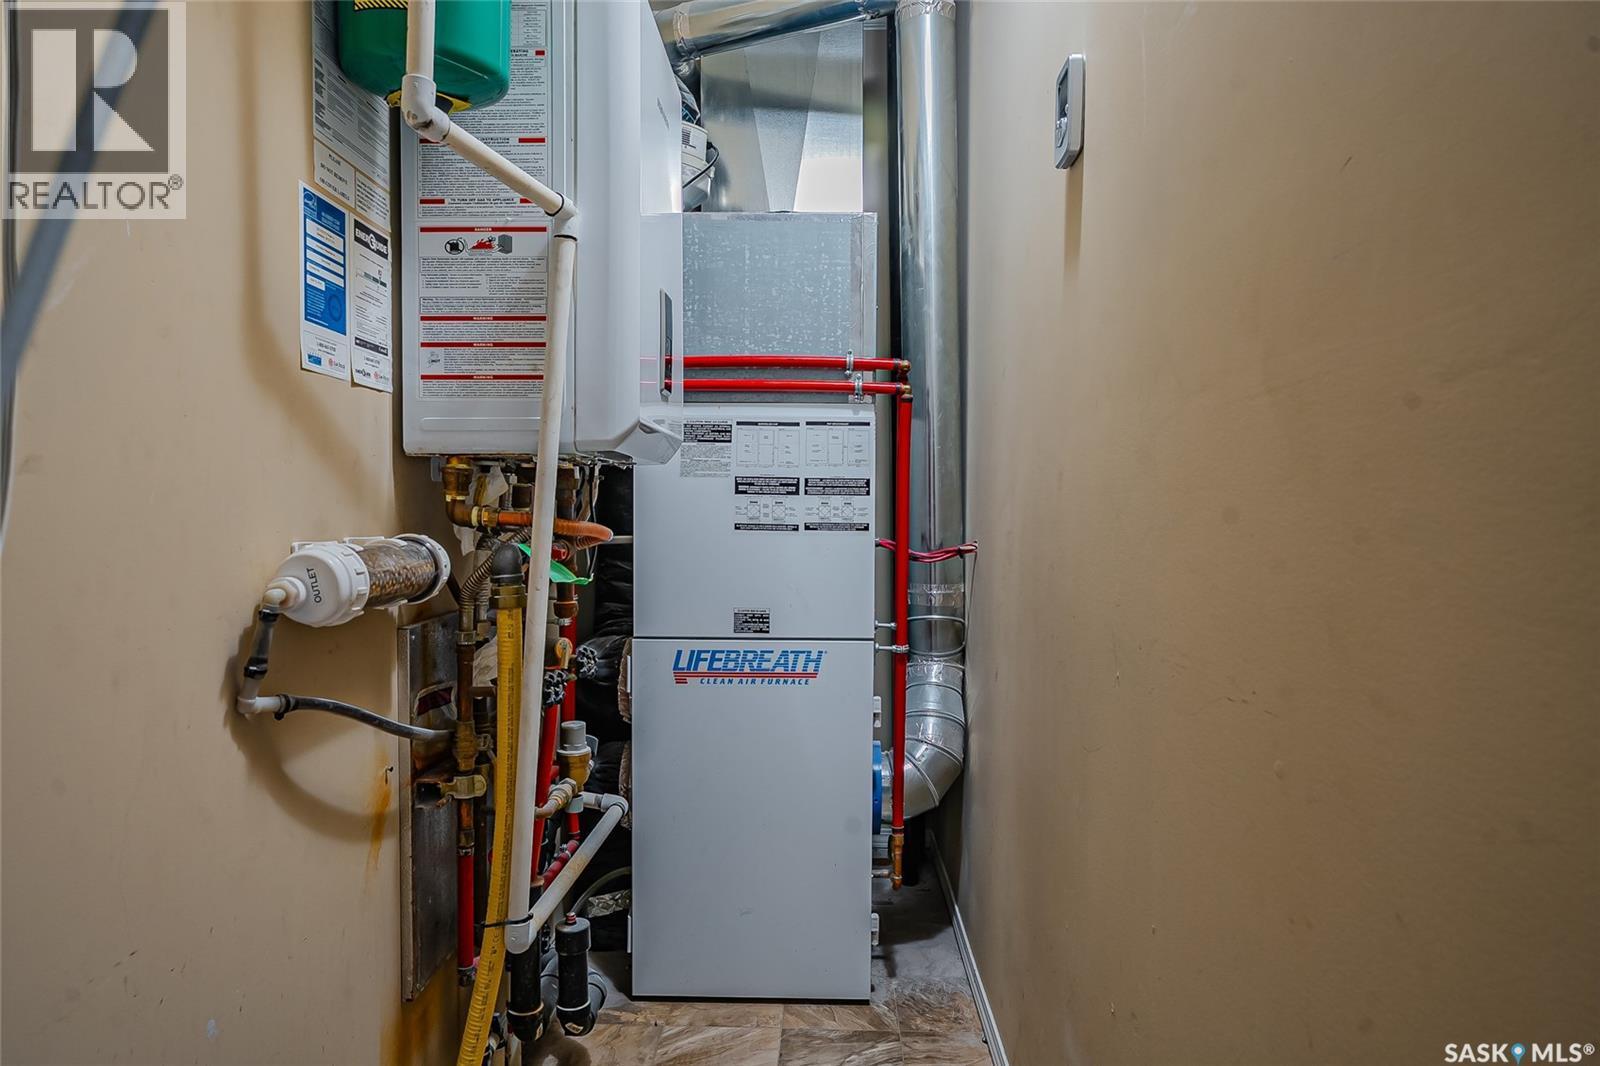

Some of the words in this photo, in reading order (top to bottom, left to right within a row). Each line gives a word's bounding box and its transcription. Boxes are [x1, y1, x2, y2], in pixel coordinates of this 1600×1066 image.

[307, 567, 322, 604] OUTLET
[672, 649, 824, 672] LIFEBREATH
[760, 678, 810, 686] FURNACE
